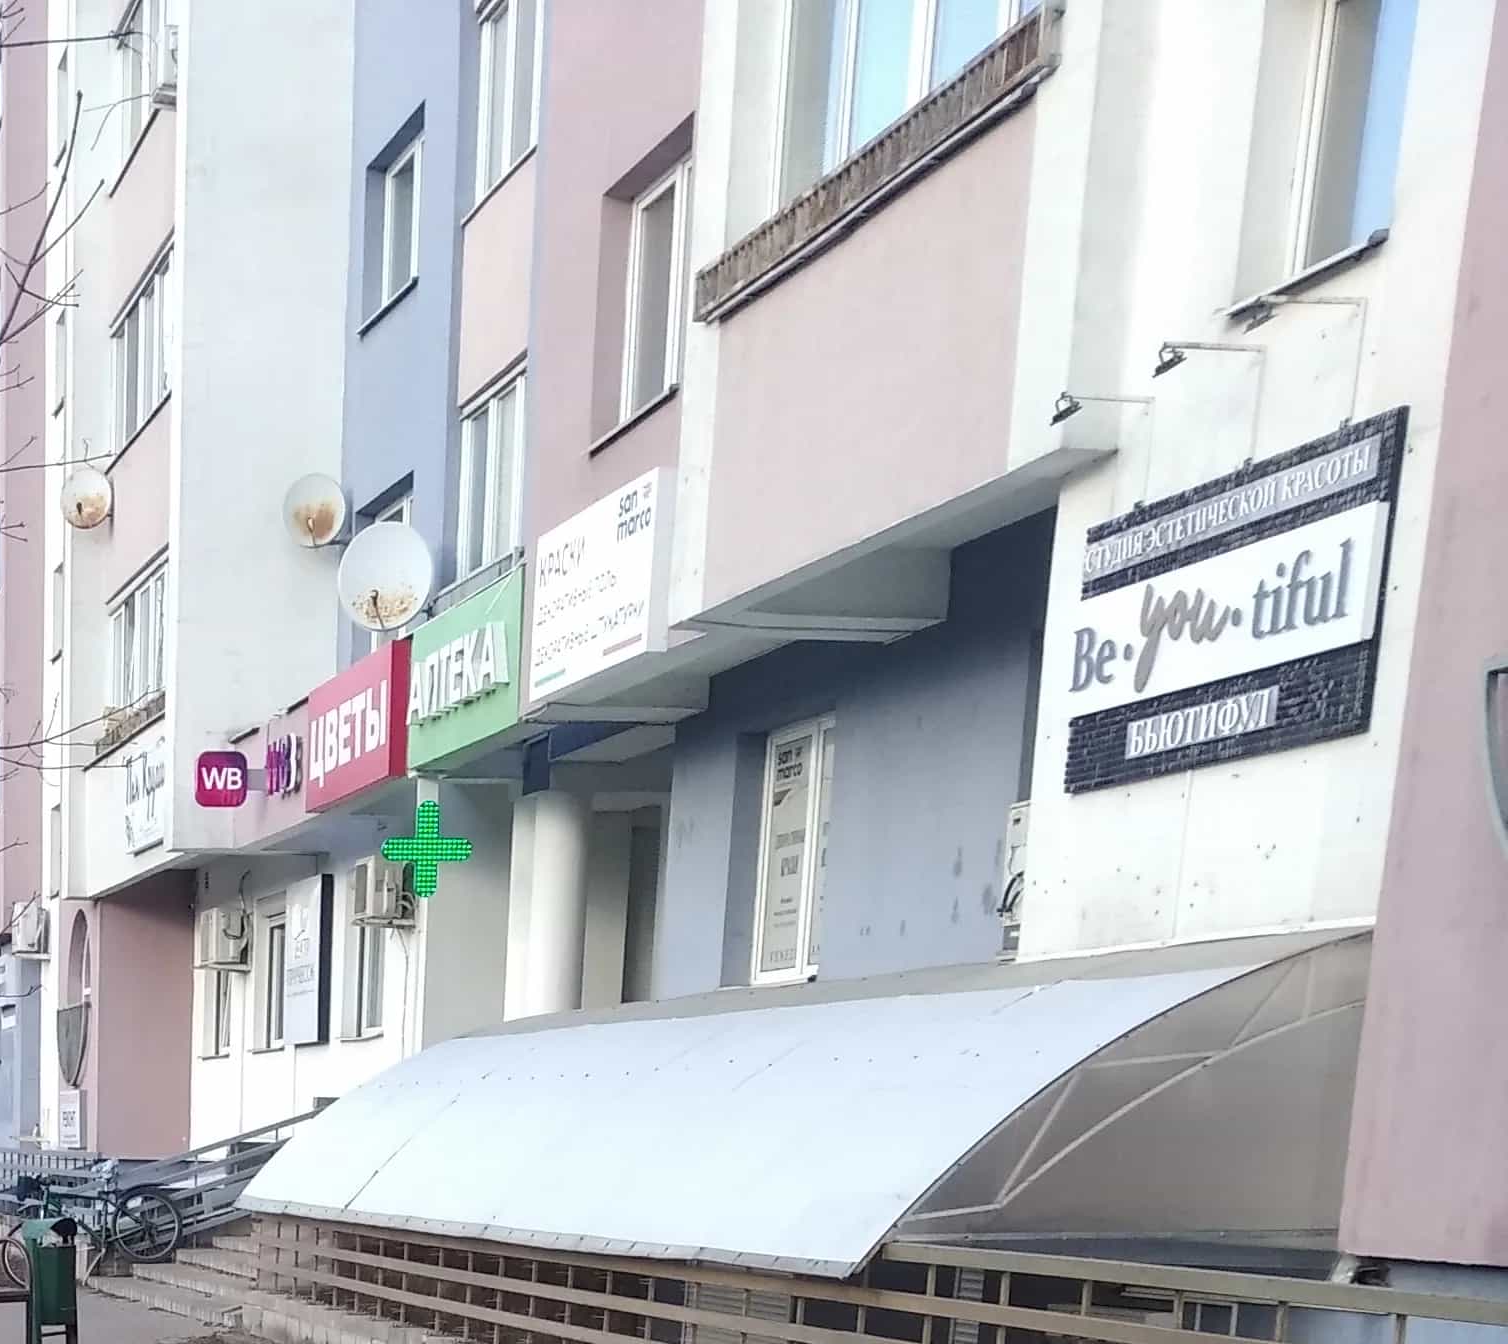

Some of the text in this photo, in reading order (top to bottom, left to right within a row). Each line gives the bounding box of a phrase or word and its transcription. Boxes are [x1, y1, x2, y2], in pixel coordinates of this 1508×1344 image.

[1084, 444, 1372, 574] СТУДИЯ ЭСТЕТИЧЕСКОЙ КРАСОТЫ
[405, 620, 510, 727] АПТЕКА
[1129, 690, 1270, 758] БЬЮТИФУЛ
[201, 766, 242, 790] WB
[308, 679, 388, 788] ЦВЕТЫ
